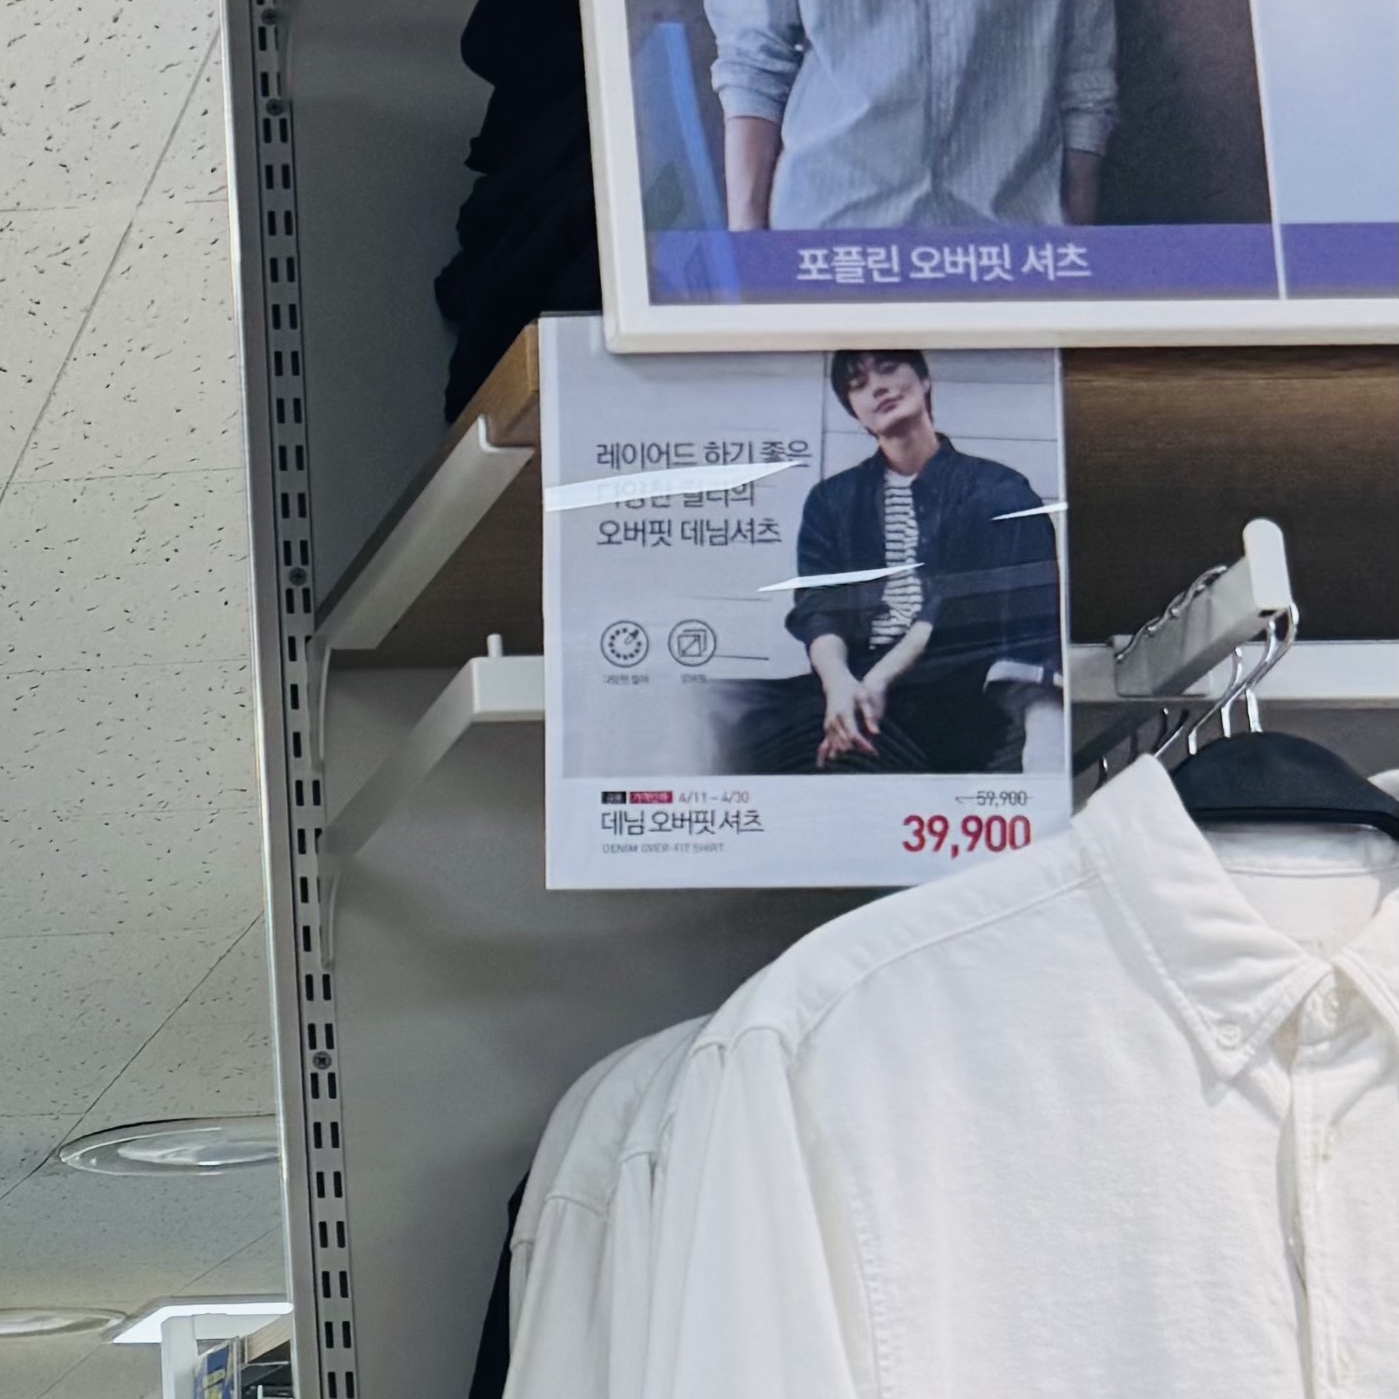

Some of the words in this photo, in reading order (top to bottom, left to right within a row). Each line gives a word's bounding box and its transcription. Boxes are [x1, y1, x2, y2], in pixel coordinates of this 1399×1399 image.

[796, 244, 901, 284] 포플린
[909, 243, 1014, 282] 오버핏
[1020, 243, 1092, 281] 셔츠
[596, 441, 697, 470] 레이어드
[703, 441, 753, 465] 하기
[596, 519, 672, 547] 오버핏
[976, 790, 1028, 808] 59,900
[601, 810, 645, 836] 데님
[649, 810, 716, 835] 오버핏
[718, 810, 765, 835] 셔츠
[902, 814, 1032, 860] 39,900
